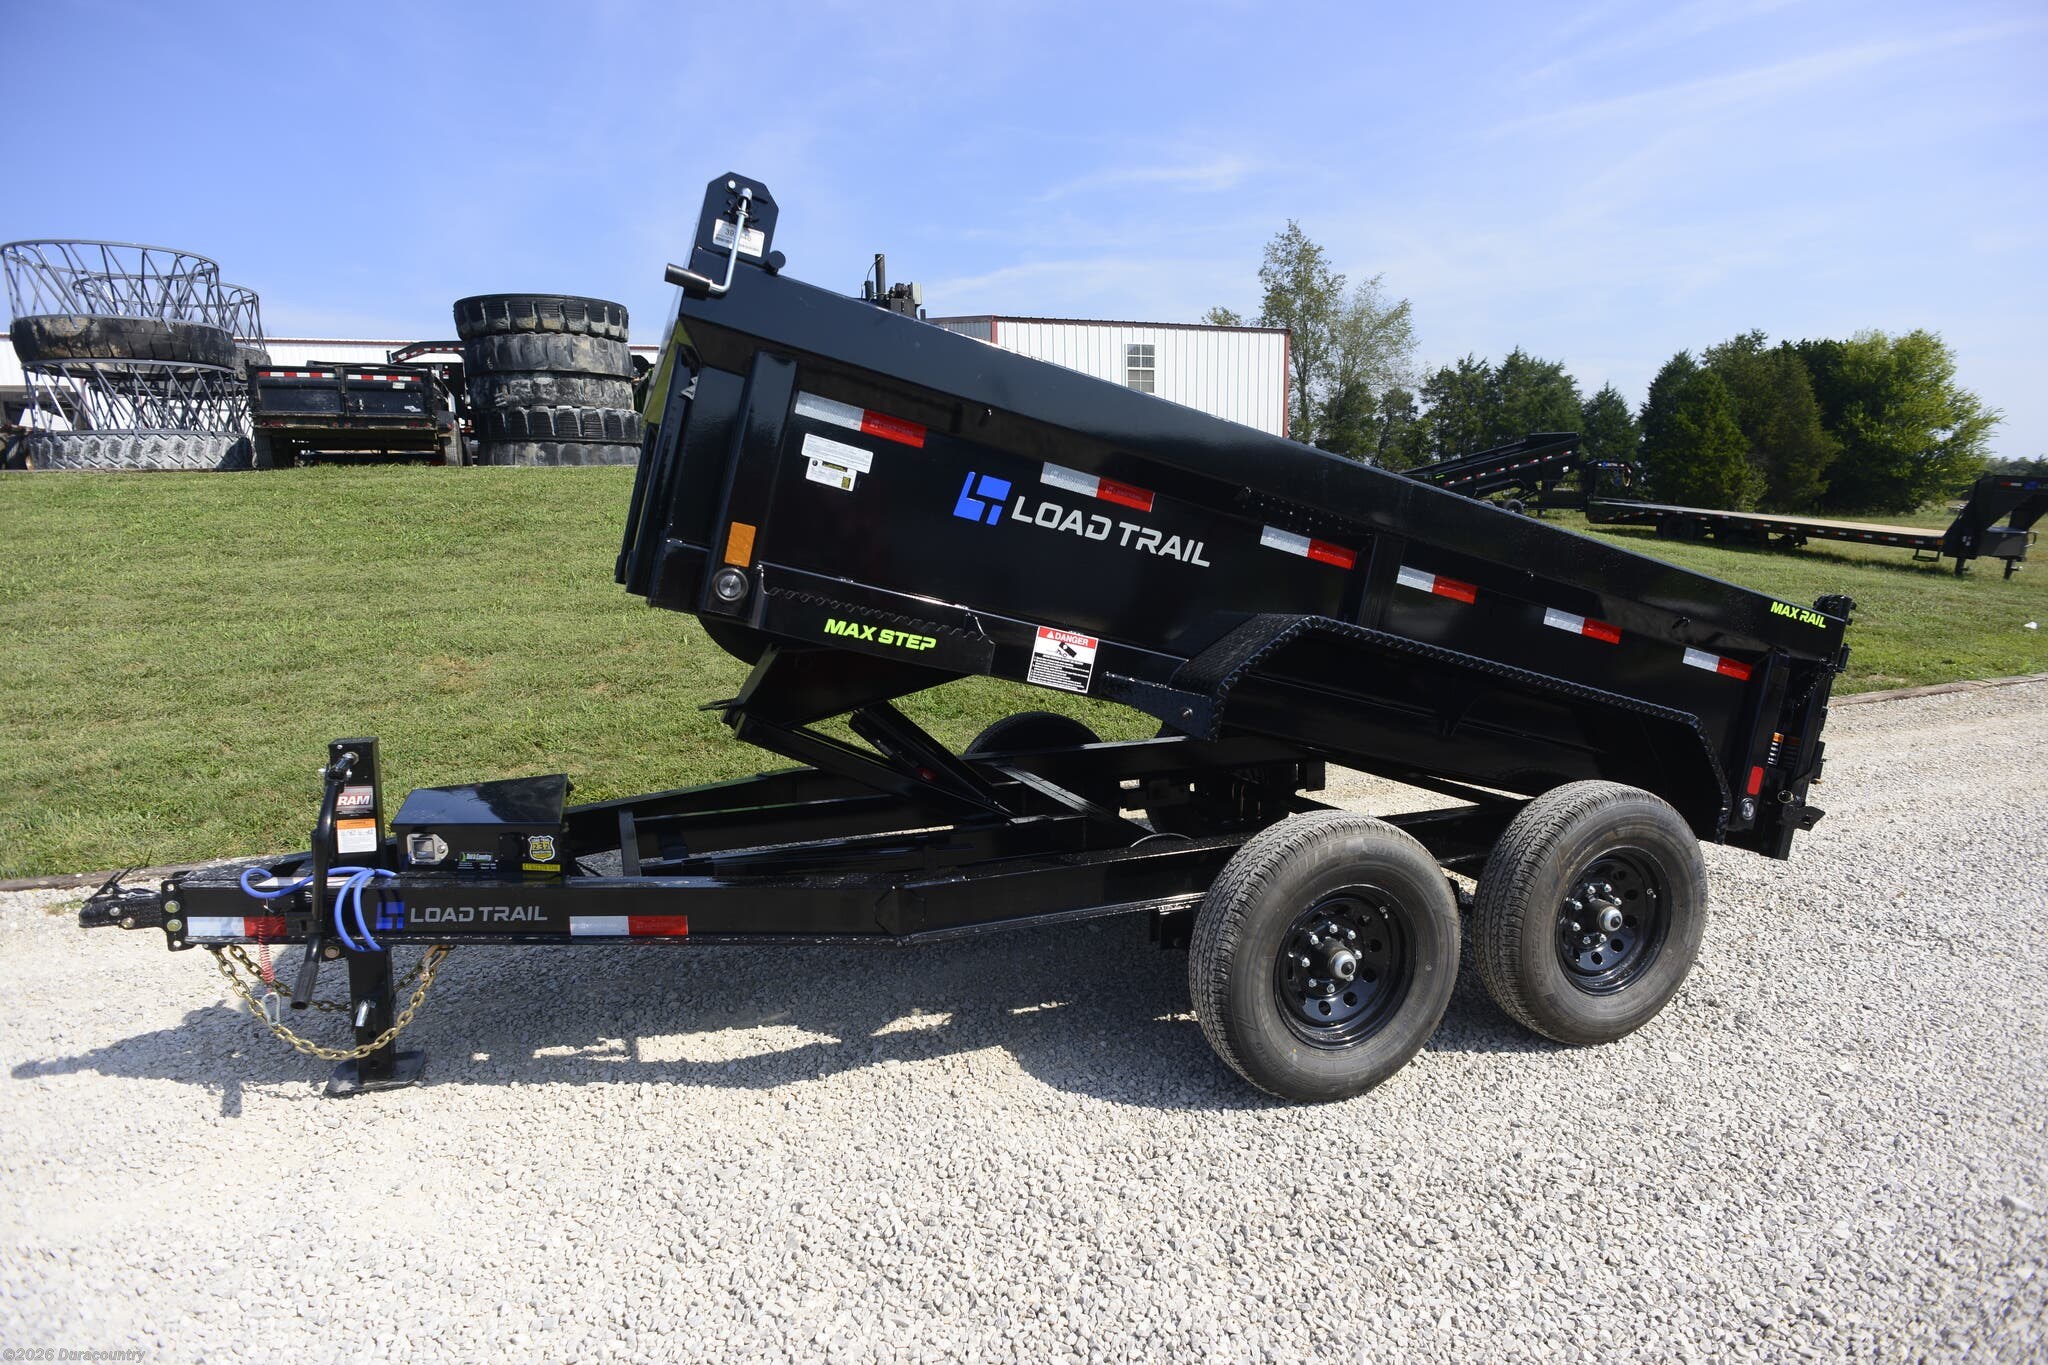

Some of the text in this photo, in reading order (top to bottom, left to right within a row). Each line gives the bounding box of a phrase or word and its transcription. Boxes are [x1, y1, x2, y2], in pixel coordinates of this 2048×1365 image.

[1011, 495, 1211, 568] LOAD TRAIL
[1770, 601, 1826, 628] MAX RAIL
[824, 618, 937, 651] MAX STEP
[1055, 632, 1089, 646] DANGER
[337, 795, 370, 806] RAM
[410, 905, 548, 923] LOAD TRAIL
